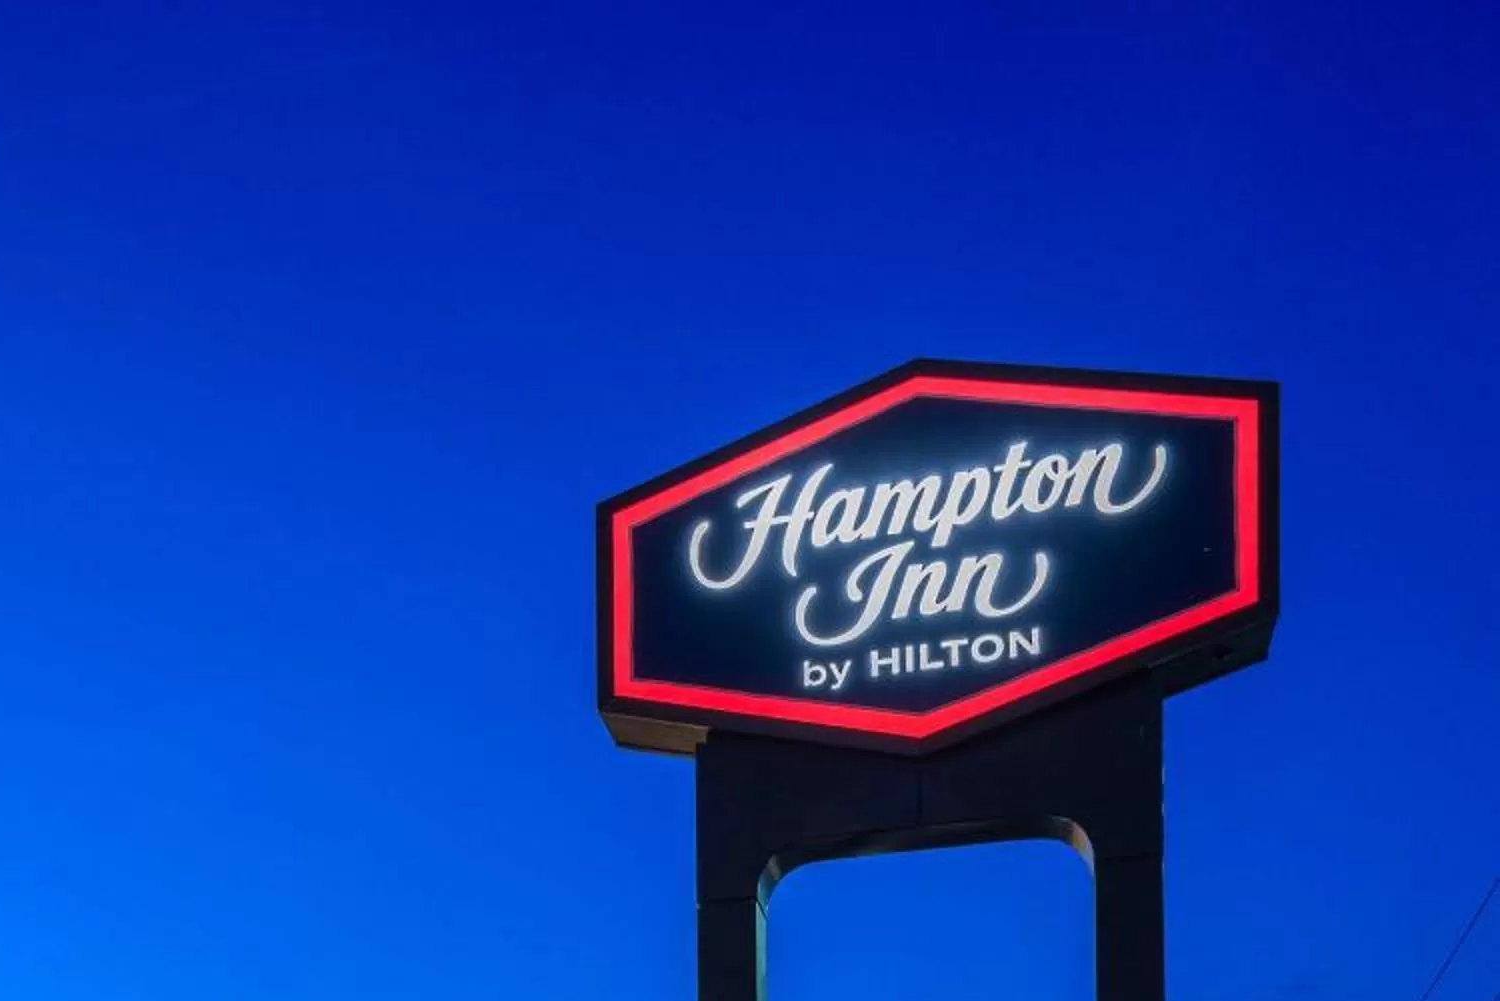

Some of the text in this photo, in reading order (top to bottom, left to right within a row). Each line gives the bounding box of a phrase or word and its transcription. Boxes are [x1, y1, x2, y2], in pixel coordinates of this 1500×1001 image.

[688, 441, 1166, 590] Hampton
[795, 540, 1049, 646] Inn
[802, 626, 1041, 690] by HILTON
